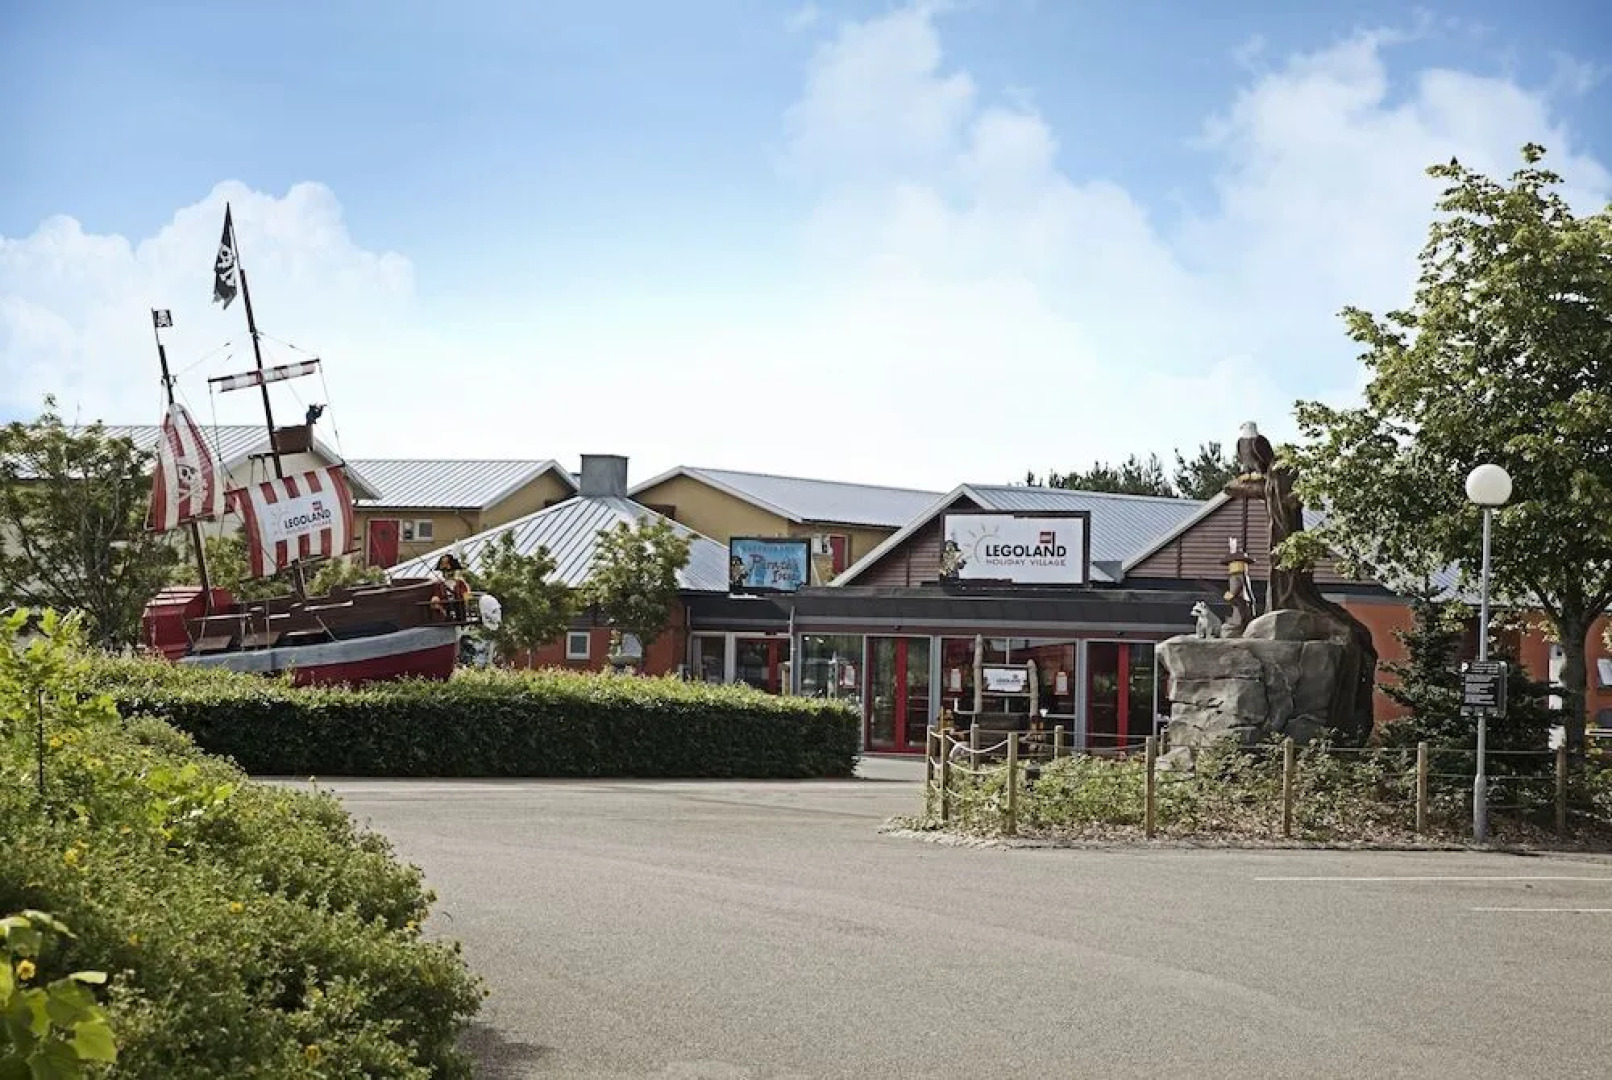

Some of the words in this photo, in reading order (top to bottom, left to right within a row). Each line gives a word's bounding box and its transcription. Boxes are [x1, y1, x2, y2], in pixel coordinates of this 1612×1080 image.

[284, 509, 331, 529] LEGOLAND
[986, 545, 1067, 557] LEGOLAND
[986, 559, 1025, 567] HOLIDAY
[1029, 559, 1067, 567] VILLAGE
